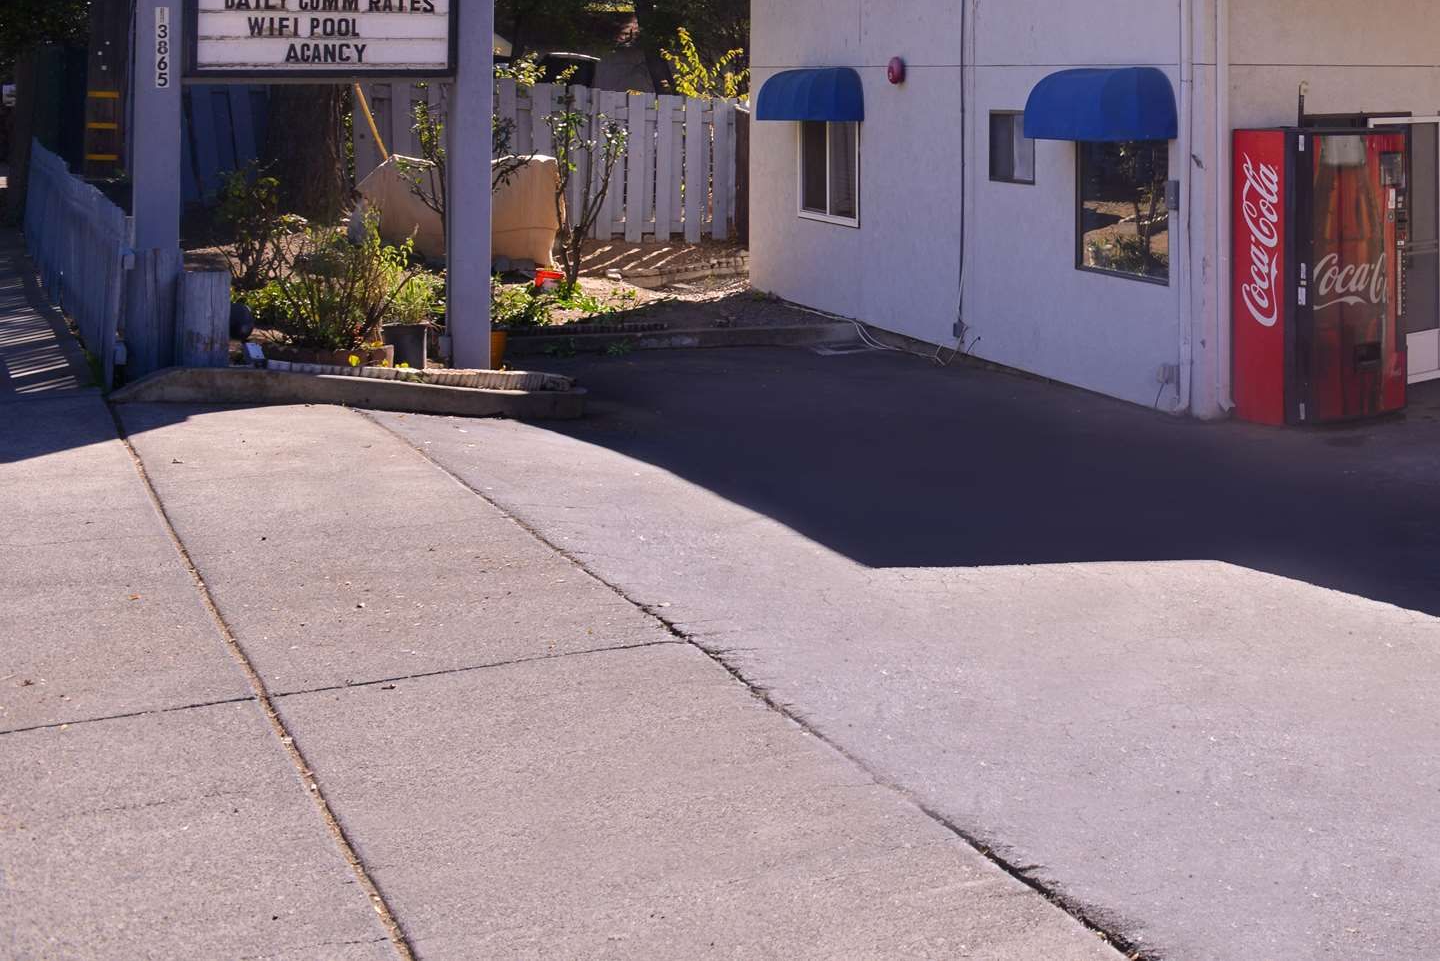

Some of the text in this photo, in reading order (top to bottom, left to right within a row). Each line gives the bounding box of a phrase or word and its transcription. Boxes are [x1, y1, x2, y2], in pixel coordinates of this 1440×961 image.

[247, 17, 360, 38] WIFI POOL
[157, 24, 169, 87] 3865
[285, 43, 367, 64] ACANCY
